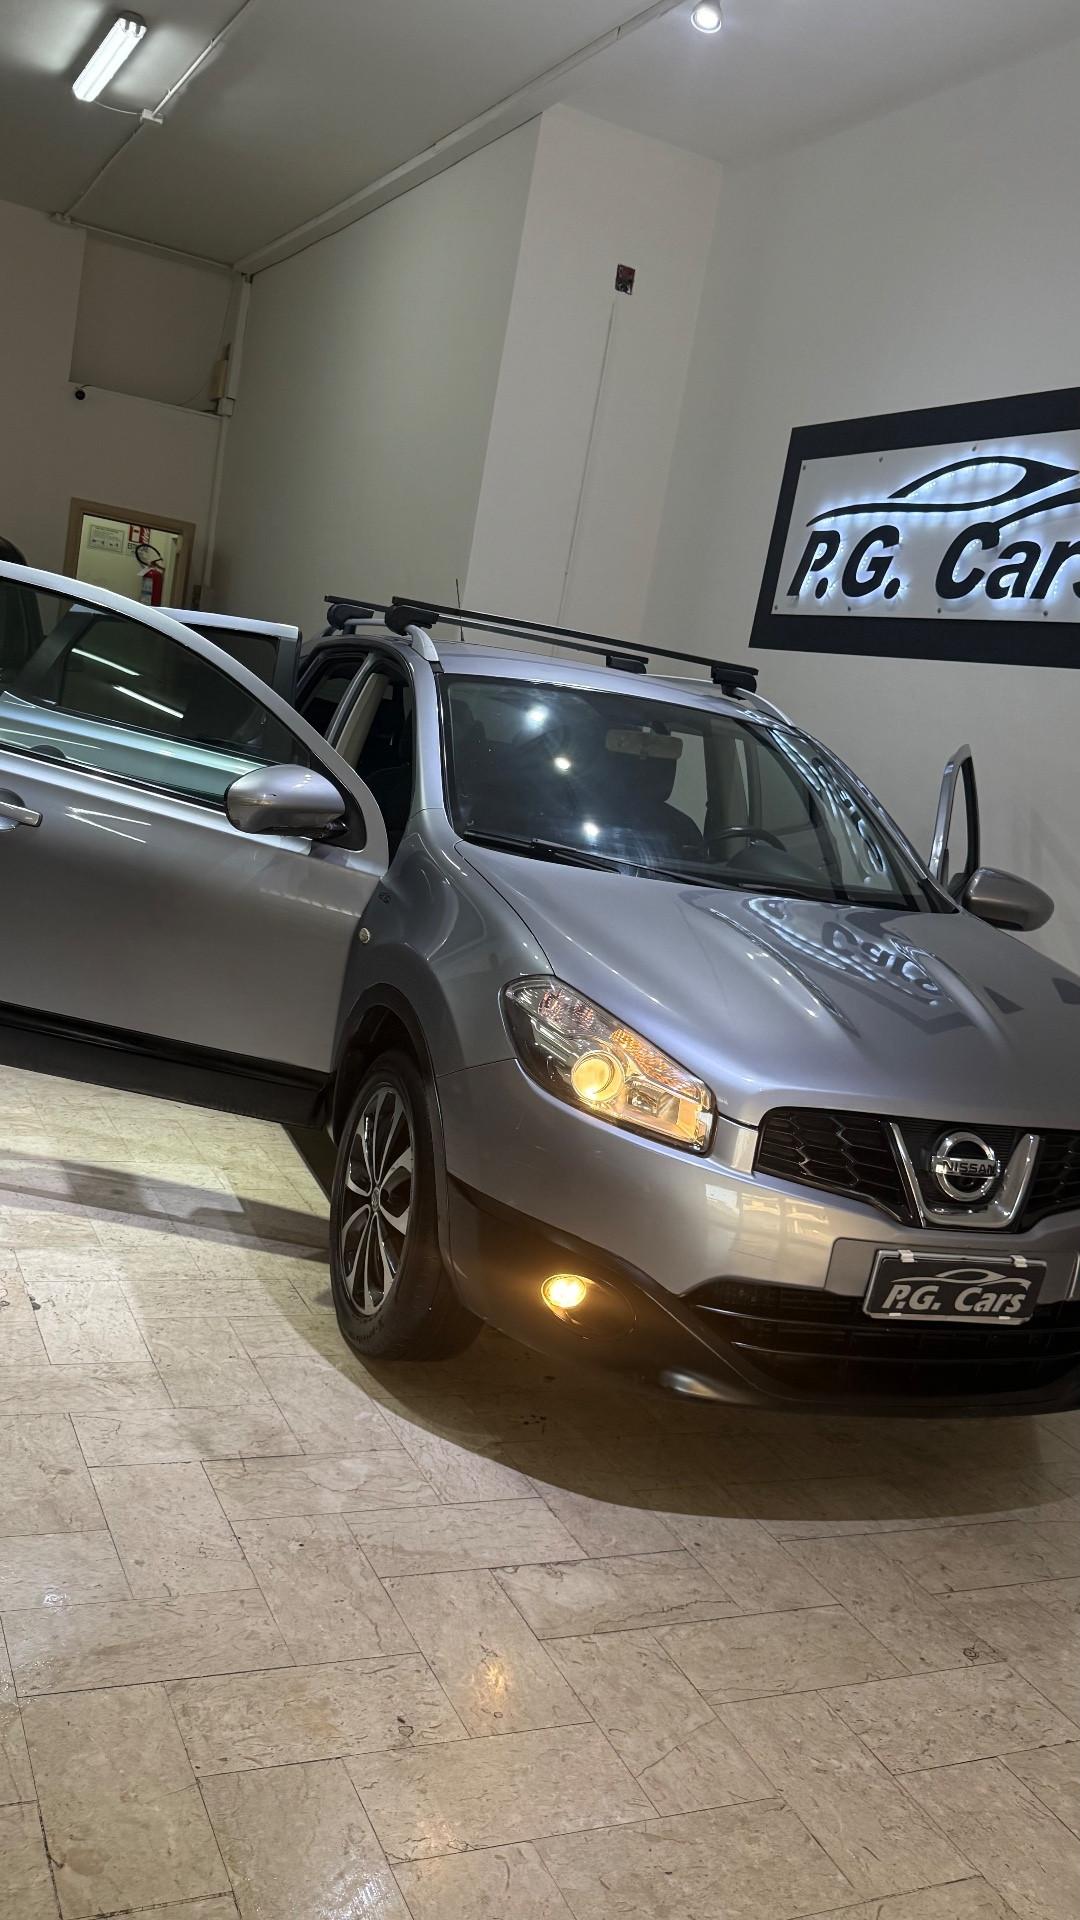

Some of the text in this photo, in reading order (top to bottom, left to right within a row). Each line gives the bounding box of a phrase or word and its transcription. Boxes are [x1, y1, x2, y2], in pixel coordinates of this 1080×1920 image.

[786, 521, 1080, 600] P.G. Car
[943, 1159, 996, 1176] NISSAN
[881, 1284, 1026, 1313] P.G. Cars
